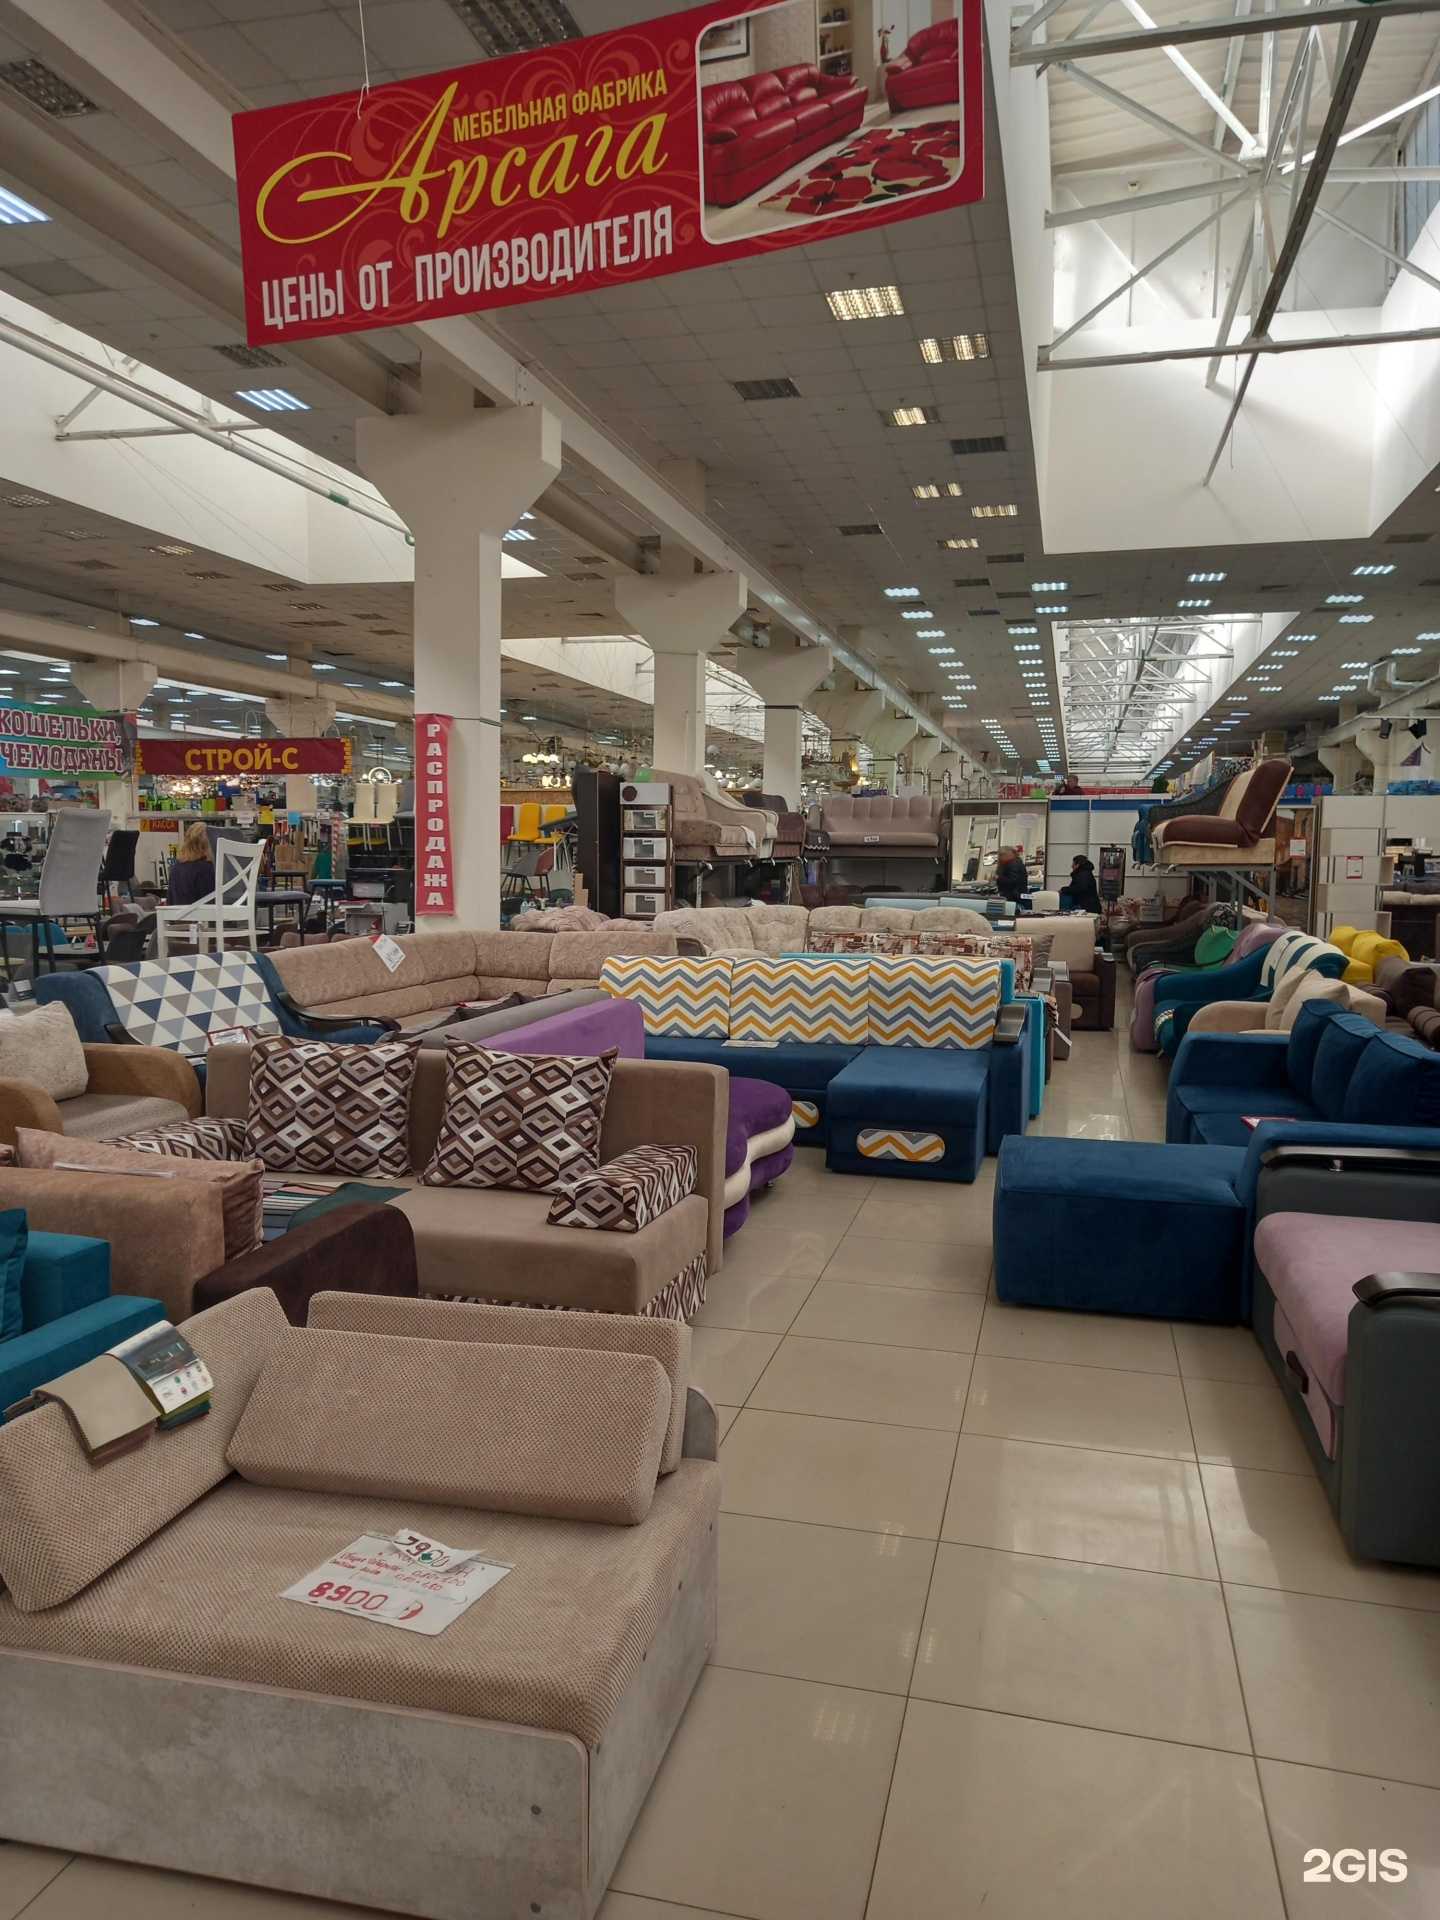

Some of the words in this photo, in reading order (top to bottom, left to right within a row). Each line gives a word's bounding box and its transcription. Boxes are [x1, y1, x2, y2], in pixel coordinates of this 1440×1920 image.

[453, 93, 568, 144] МЕБЕЛЬНАЯ
[572, 68, 668, 116] ФАБРИКА
[256, 80, 669, 244] Арсага
[261, 269, 344, 330] ЦЕНЫ
[358, 260, 393, 311] ОТ
[415, 204, 673, 303] ПРОИЗВОДИТЕЛЯ
[0, 741, 125, 775] ЧЕМОДАНЫ
[184, 743, 299, 771] СТРОЙ-С
[423, 723, 448, 906] РАСПРОДАЖА
[308, 1582, 388, 1610] 8900
